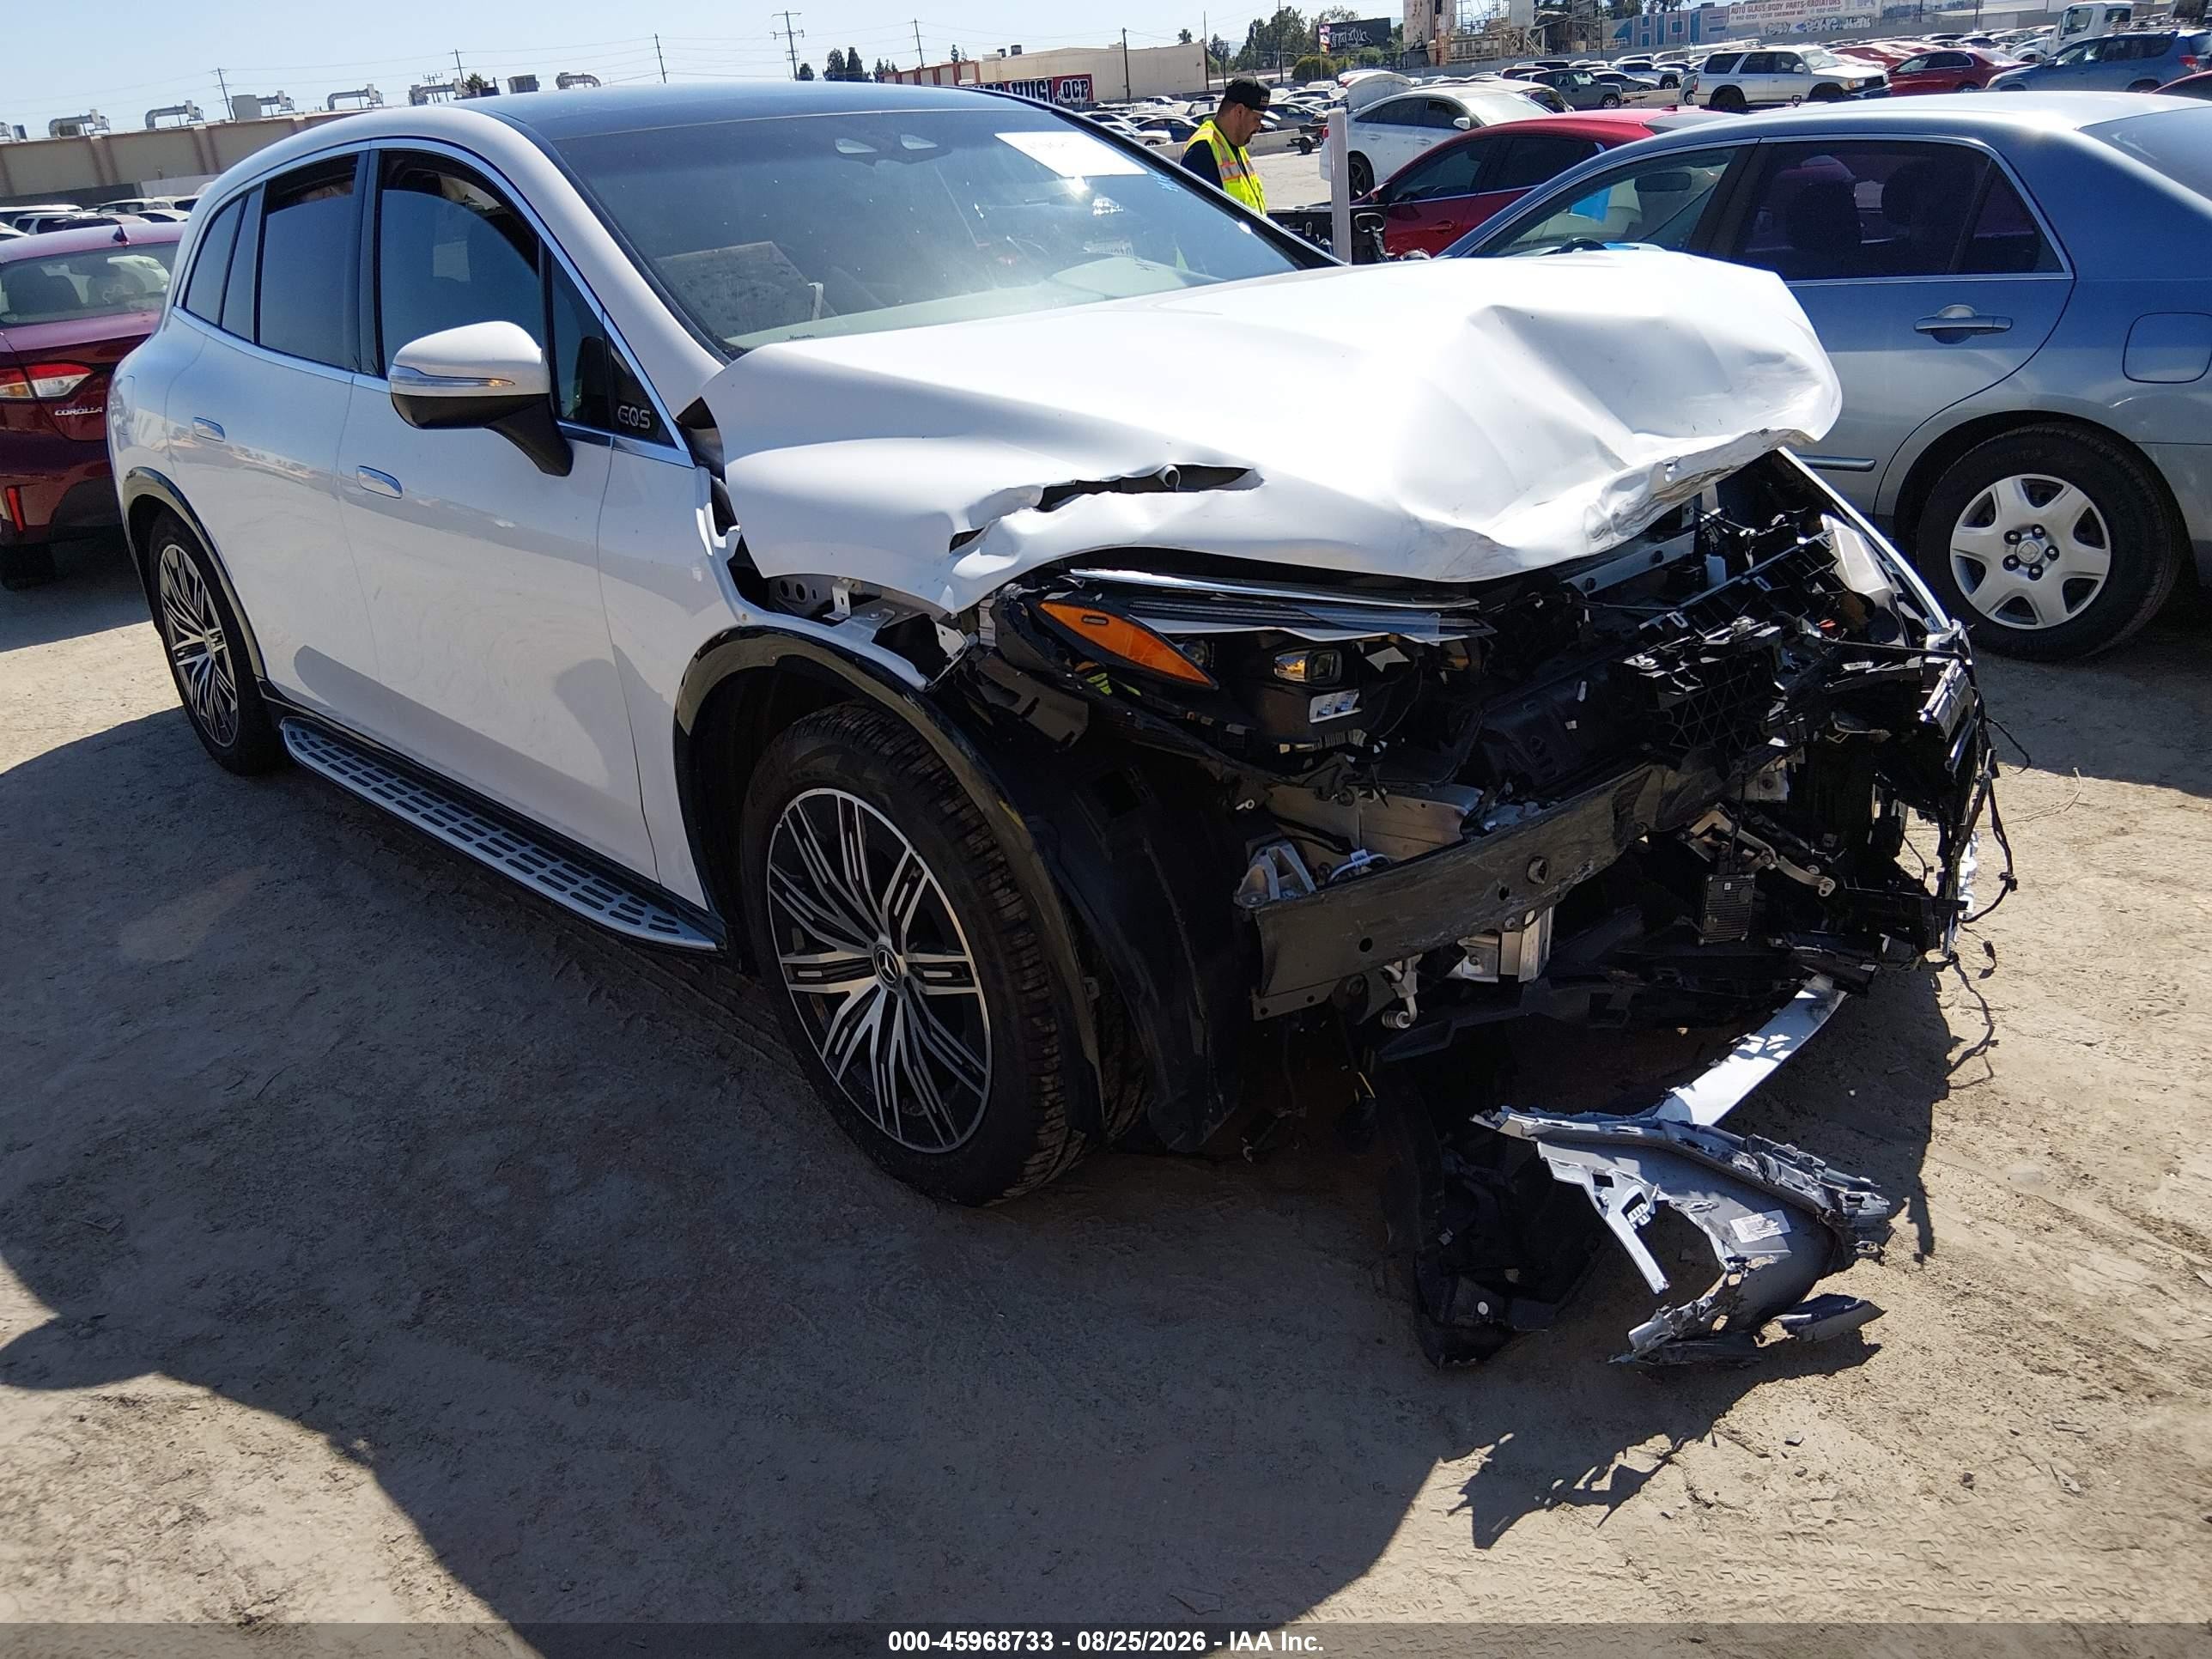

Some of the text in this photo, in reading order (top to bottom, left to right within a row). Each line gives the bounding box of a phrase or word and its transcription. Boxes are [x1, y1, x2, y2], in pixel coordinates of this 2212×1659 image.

[1730, 6, 1746, 15] AUTO
[54, 406, 103, 416] COROLLA
[617, 405, 651, 429] EQS
